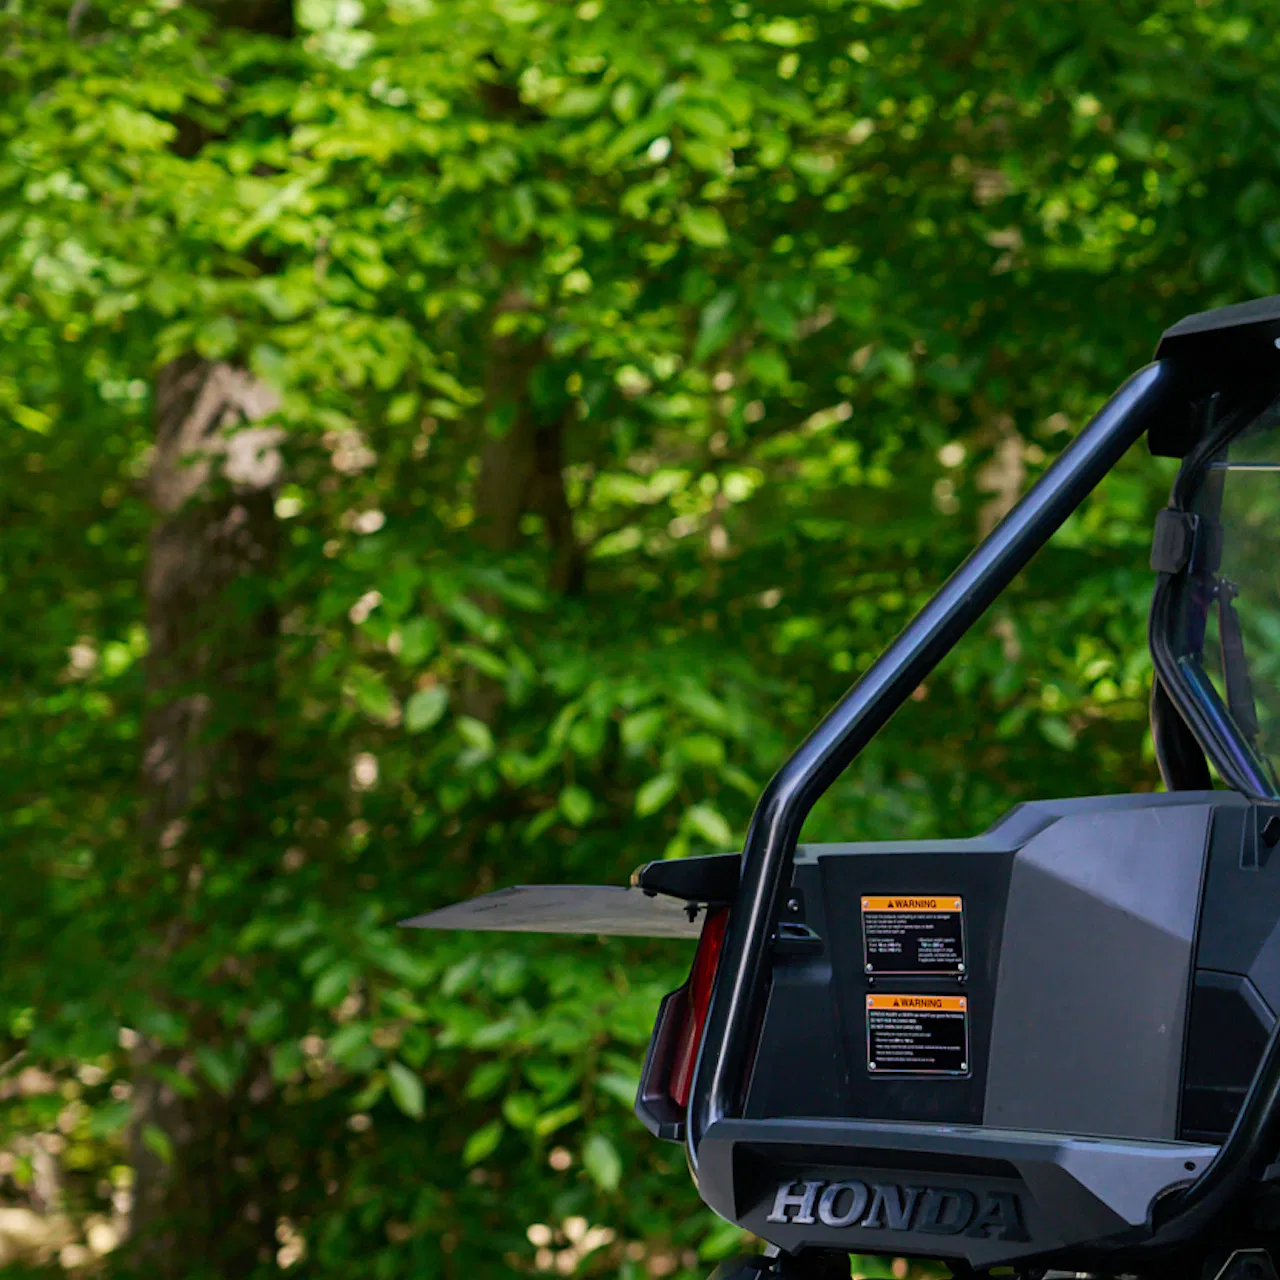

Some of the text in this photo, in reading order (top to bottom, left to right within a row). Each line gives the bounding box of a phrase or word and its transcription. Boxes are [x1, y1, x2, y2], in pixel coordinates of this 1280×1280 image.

[895, 900, 937, 908] WARNING
[901, 1000, 942, 1008] WARNING
[767, 1180, 1032, 1242] HONDA
